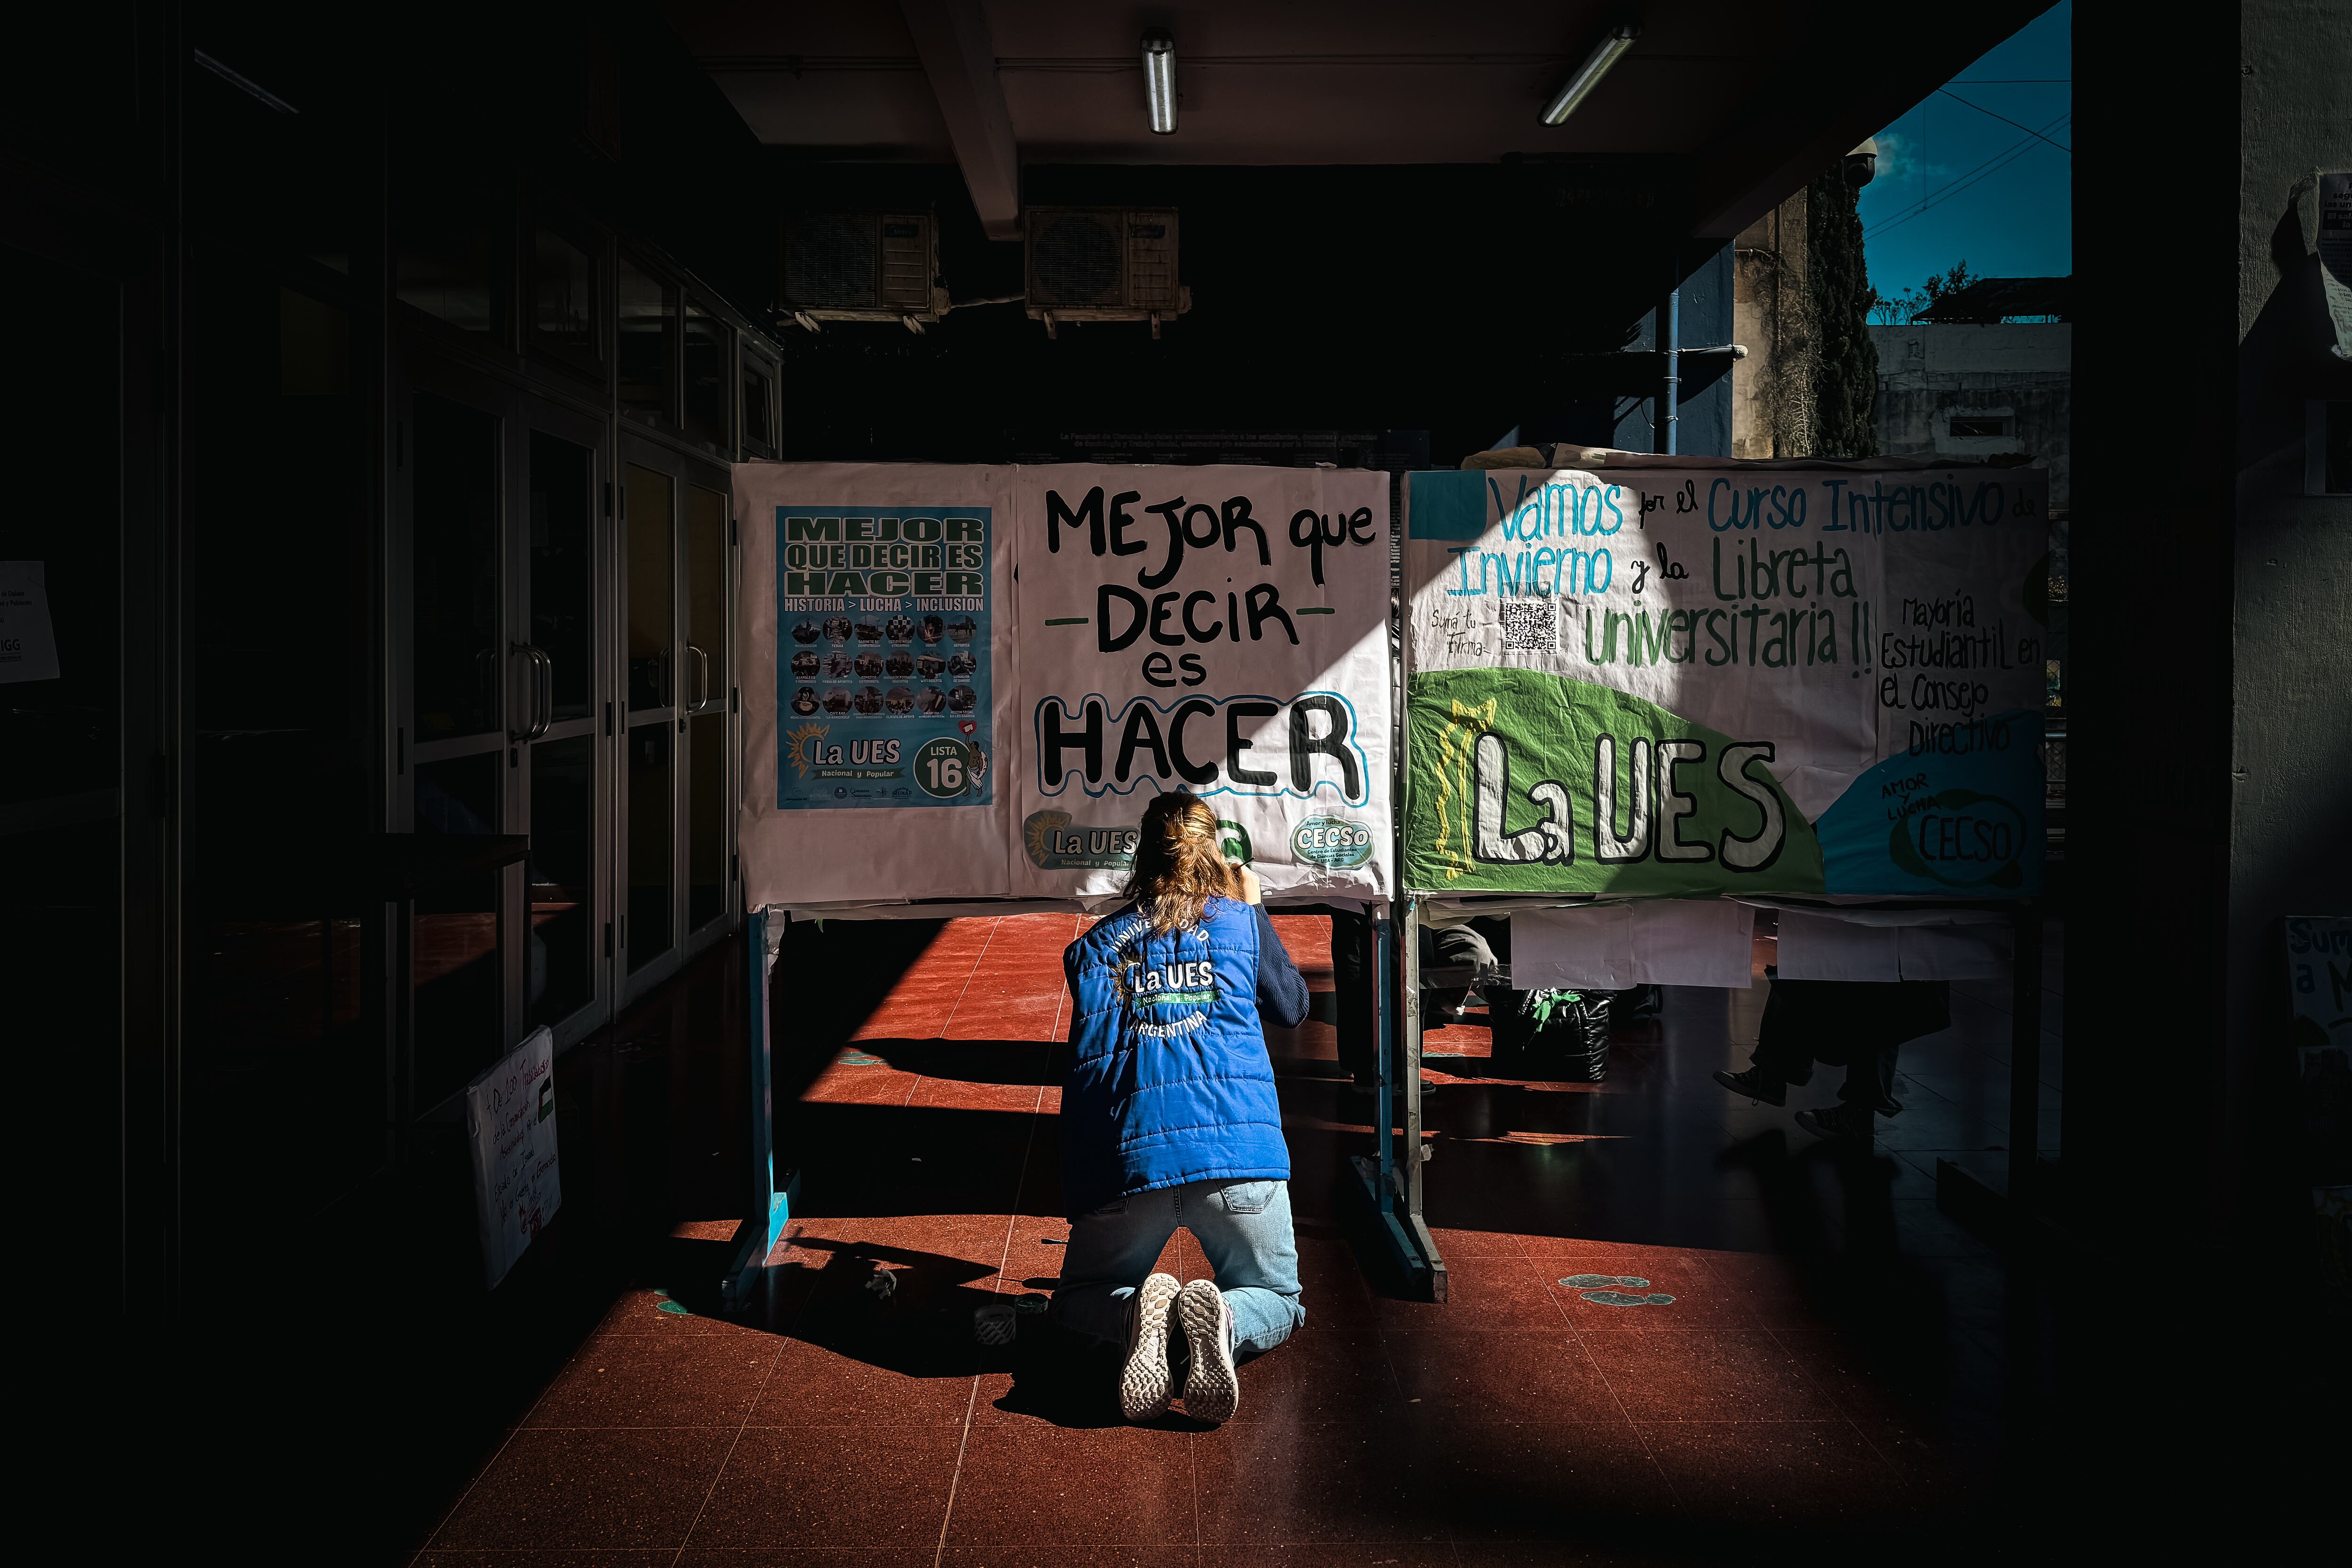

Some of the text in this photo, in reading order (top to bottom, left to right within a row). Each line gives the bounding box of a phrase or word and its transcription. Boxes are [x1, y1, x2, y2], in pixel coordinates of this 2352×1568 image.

[1488, 474, 2037, 542] Vamos por el Curso Intensivo de
[785, 517, 984, 543] MEJOR
[1045, 486, 1376, 589] MEJOR que
[785, 544, 984, 571] QUE DECIR ES
[1446, 536, 1858, 601] Invierno y la Libreta
[785, 571, 984, 597] HACER
[785, 598, 984, 612] HISTORIA LUCHA INCLUSION
[1903, 588, 1975, 631] Mayoría
[2018, 635, 2041, 665] en
[1142, 652, 1207, 687] es
[1911, 673, 1989, 717] Consejo
[1043, 695, 1360, 800] HACER
[1909, 713, 2011, 756] Directivo
[813, 739, 901, 765] La UES
[930, 747, 957, 756] LISTA
[927, 758, 963, 789] 16
[1882, 772, 1929, 799] AMOR
[1472, 731, 1787, 873] La UES
[1888, 796, 1942, 821] LUCHA
[1053, 830, 1138, 854] La UES
[1919, 814, 2011, 862] CECSO
[1134, 961, 1213, 993] La UES
[2296, 964, 2315, 994] a
[1130, 1011, 1208, 1038] ARGENTINA
[505, 1075, 517, 1105] 100
[520, 1142, 534, 1171] Israel
